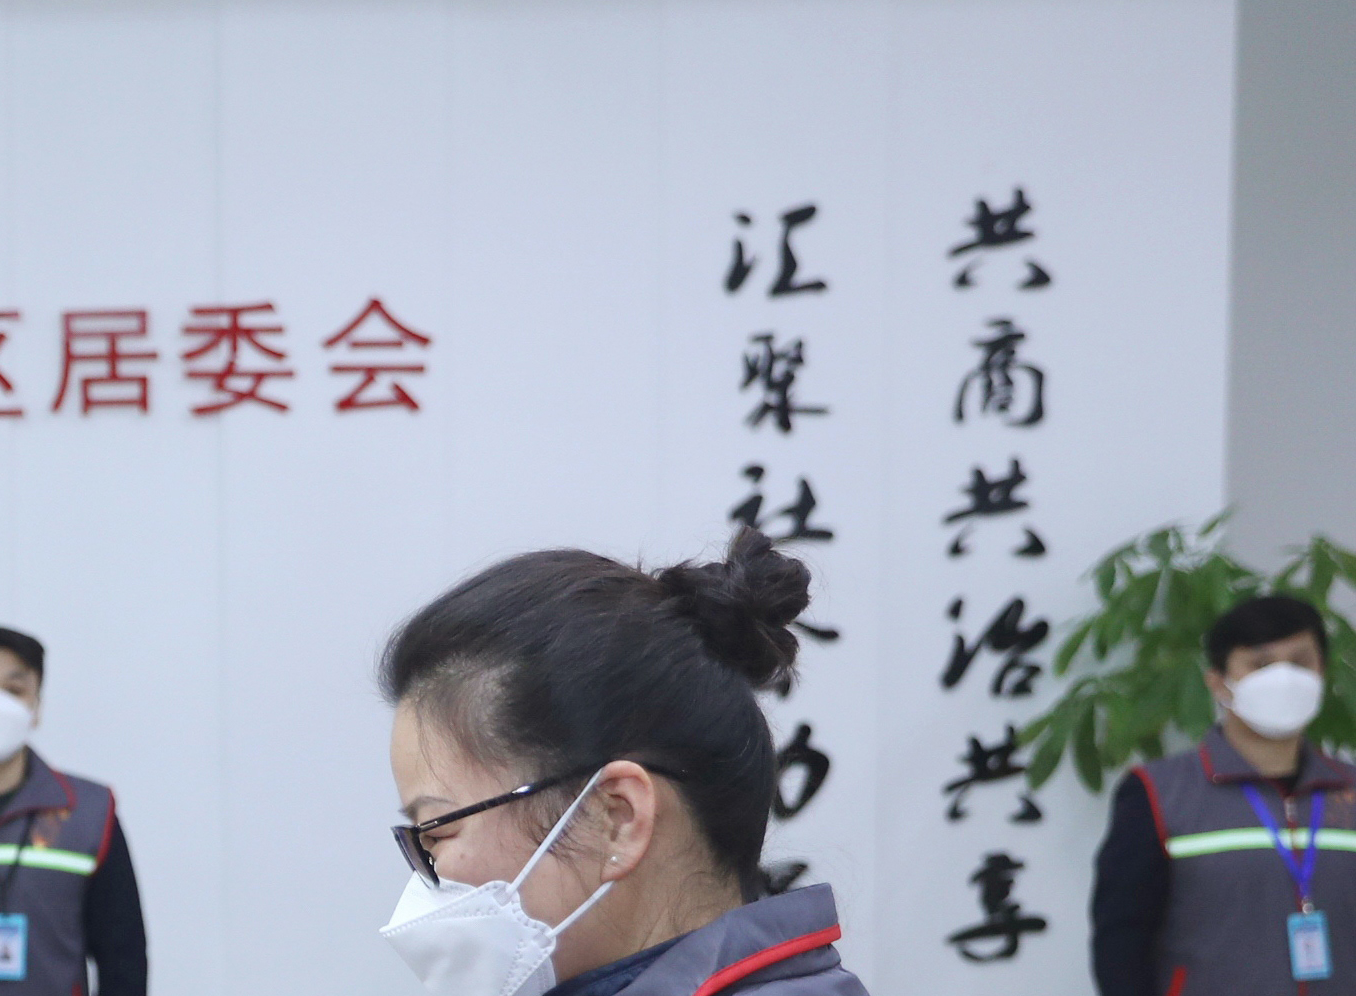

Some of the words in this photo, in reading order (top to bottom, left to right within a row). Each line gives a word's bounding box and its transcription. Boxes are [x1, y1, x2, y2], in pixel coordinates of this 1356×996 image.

[939, 188, 1053, 963] 共商共治共享
